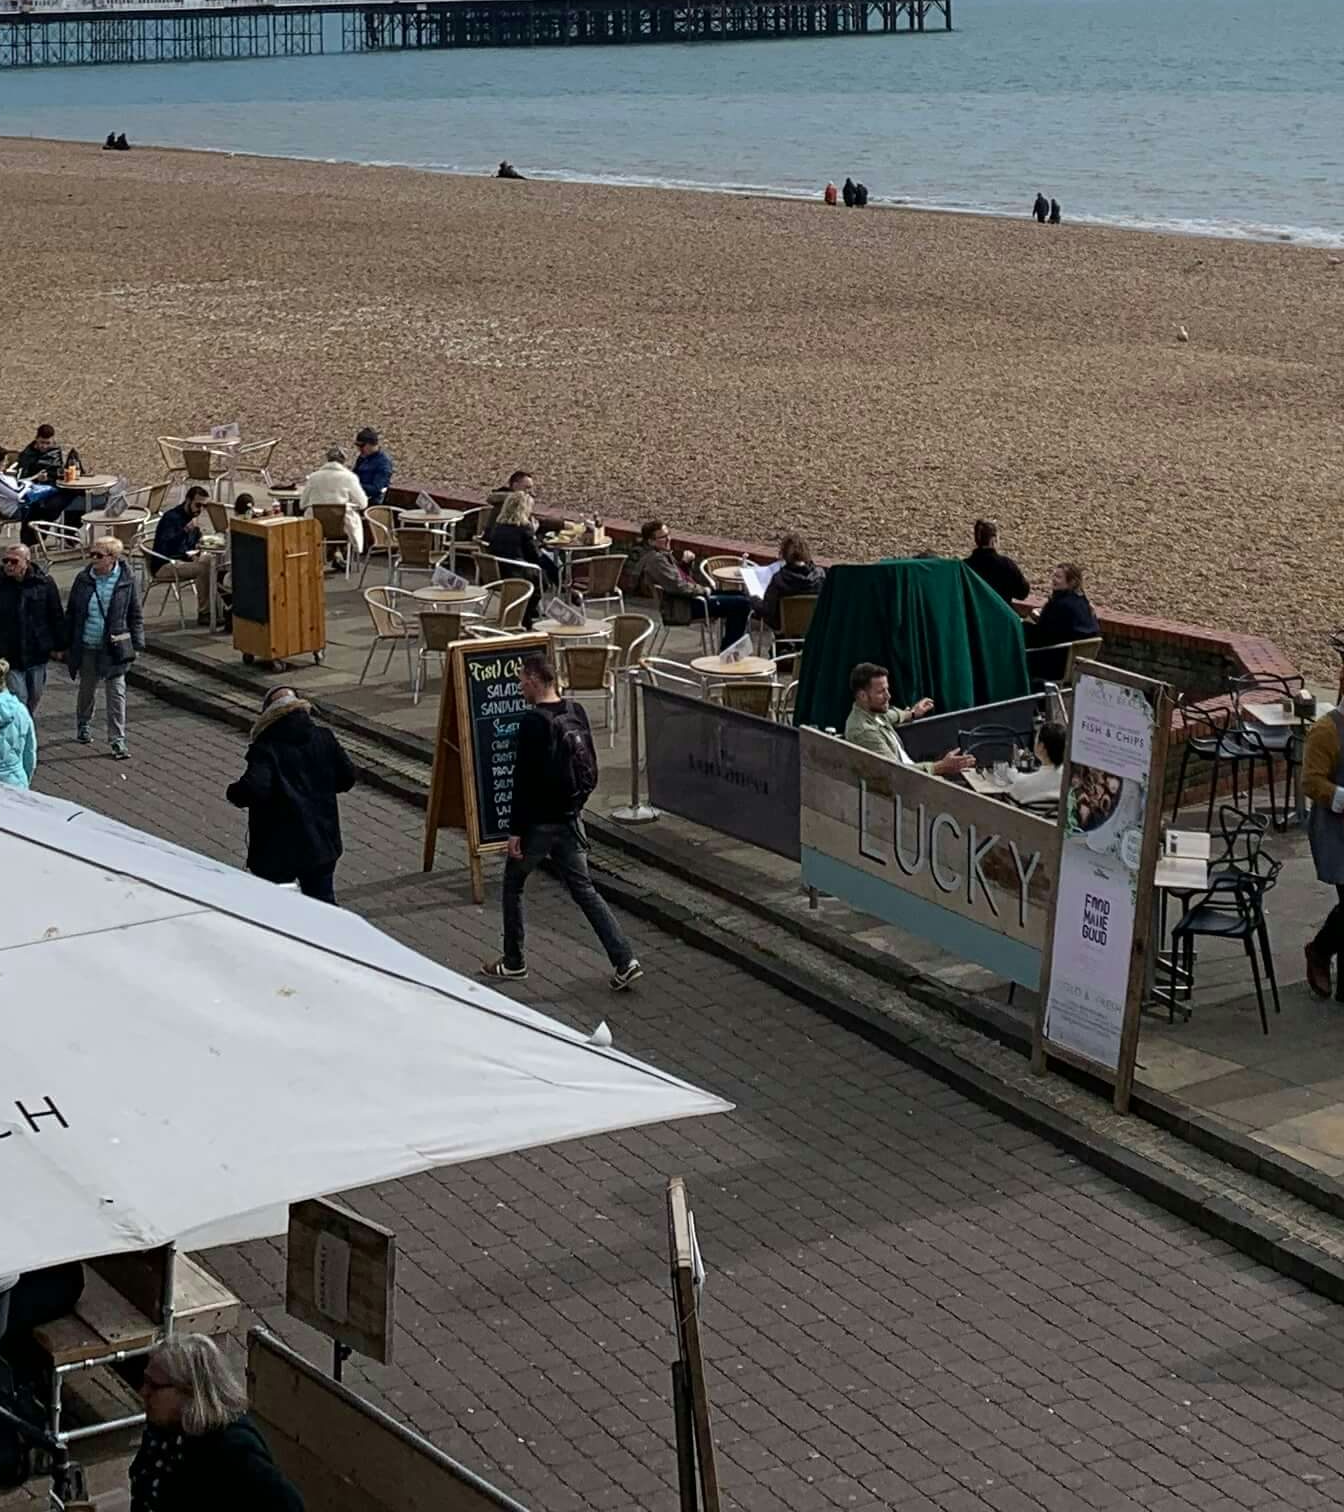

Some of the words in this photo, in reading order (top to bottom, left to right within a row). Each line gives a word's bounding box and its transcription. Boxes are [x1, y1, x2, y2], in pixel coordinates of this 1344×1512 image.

[1081, 720, 1102, 735] FISH
[1105, 728, 1112, 738] &
[1116, 731, 1144, 748] CHIPS
[858, 779, 1040, 927] LUCKY
